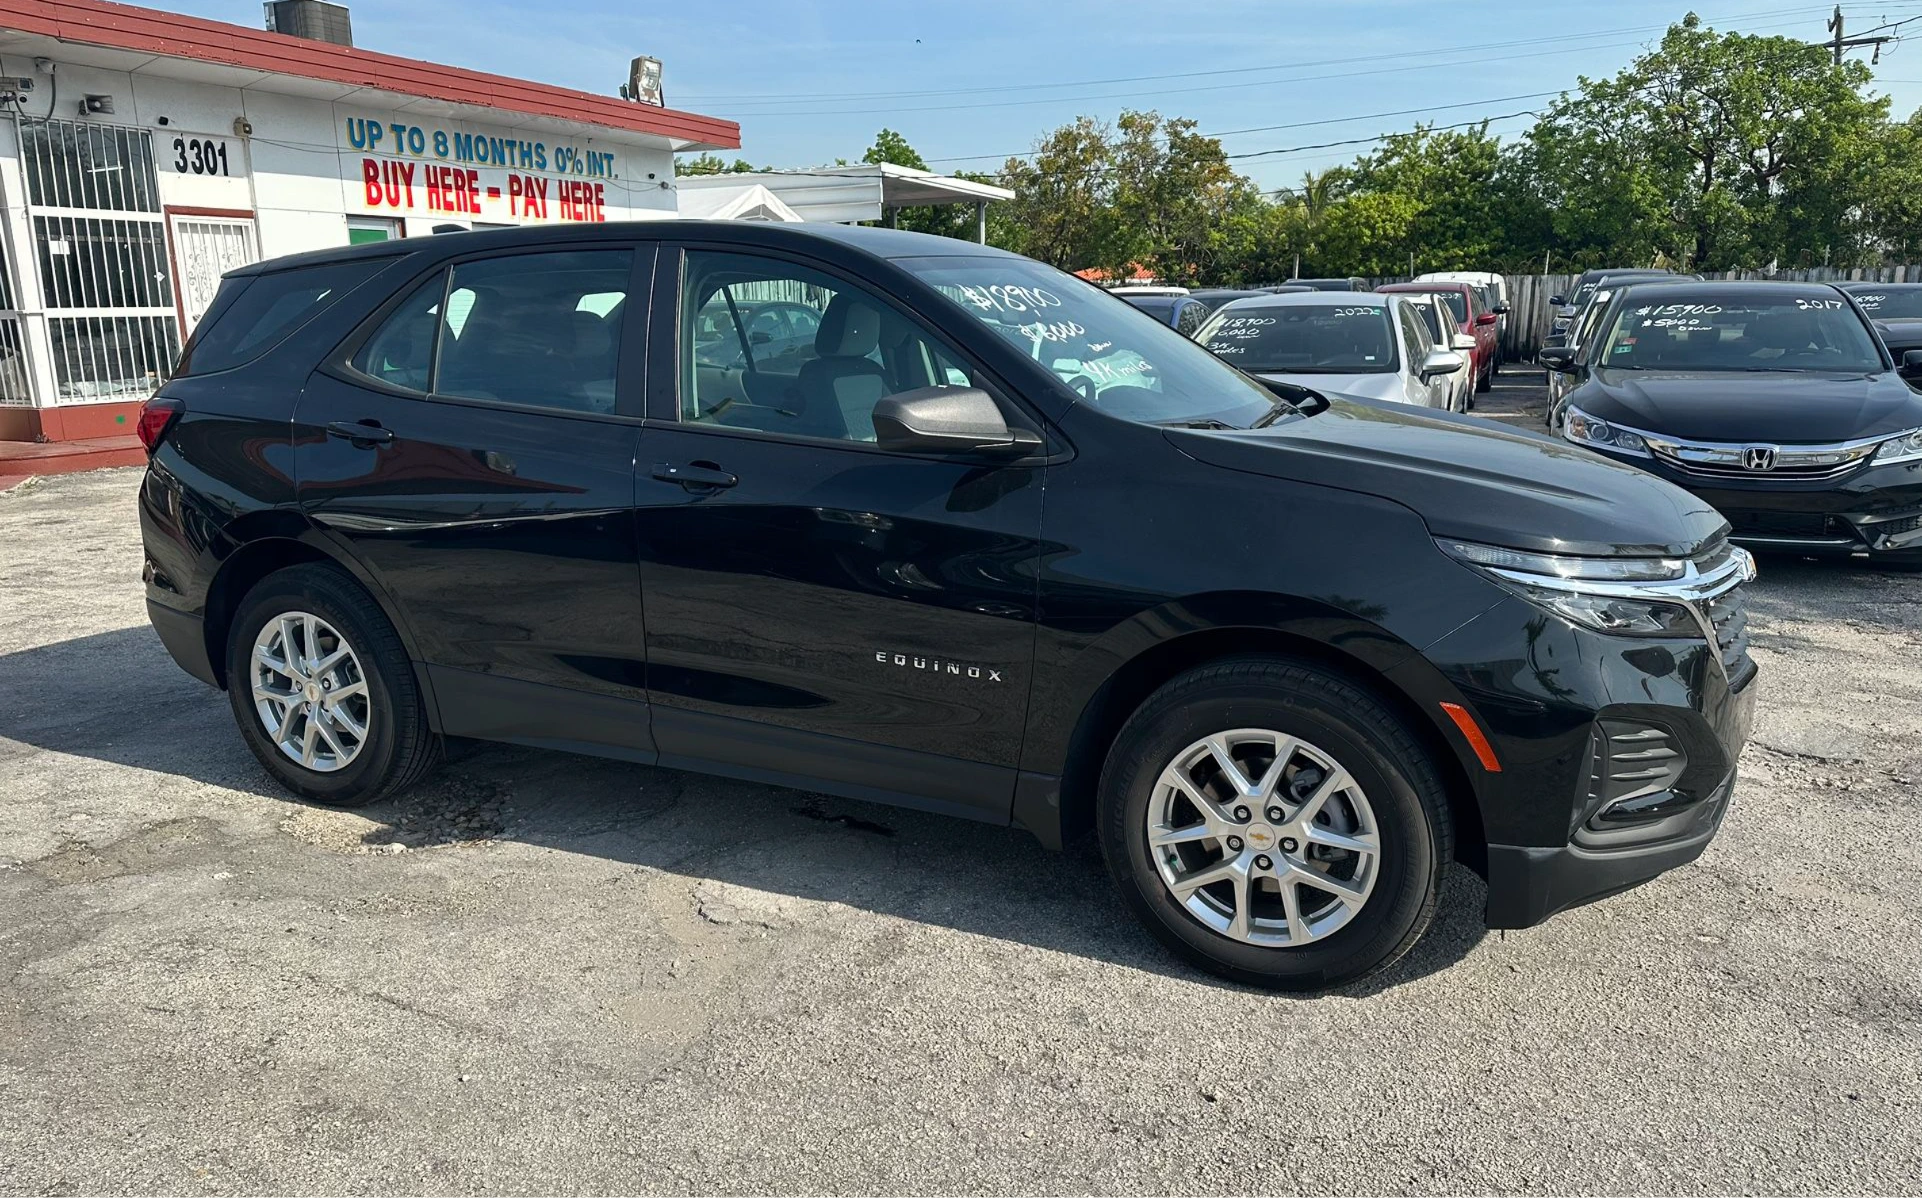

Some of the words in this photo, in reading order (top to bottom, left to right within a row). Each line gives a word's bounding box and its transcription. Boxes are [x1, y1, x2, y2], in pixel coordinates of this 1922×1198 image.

[173, 138, 229, 176] 3301
[346, 117, 383, 151] UP
[389, 123, 425, 155] TO
[432, 130, 449, 158] 8
[453, 131, 547, 170] MONTHS
[554, 146, 584, 174] 0%
[586, 149, 619, 179] INT.
[362, 158, 415, 208] BUY
[424, 163, 482, 214] HERE
[508, 173, 548, 219] PAY
[557, 179, 605, 222] HERE
[1795, 299, 1843, 310] 2017
[875, 651, 1002, 682] EQUINOX
